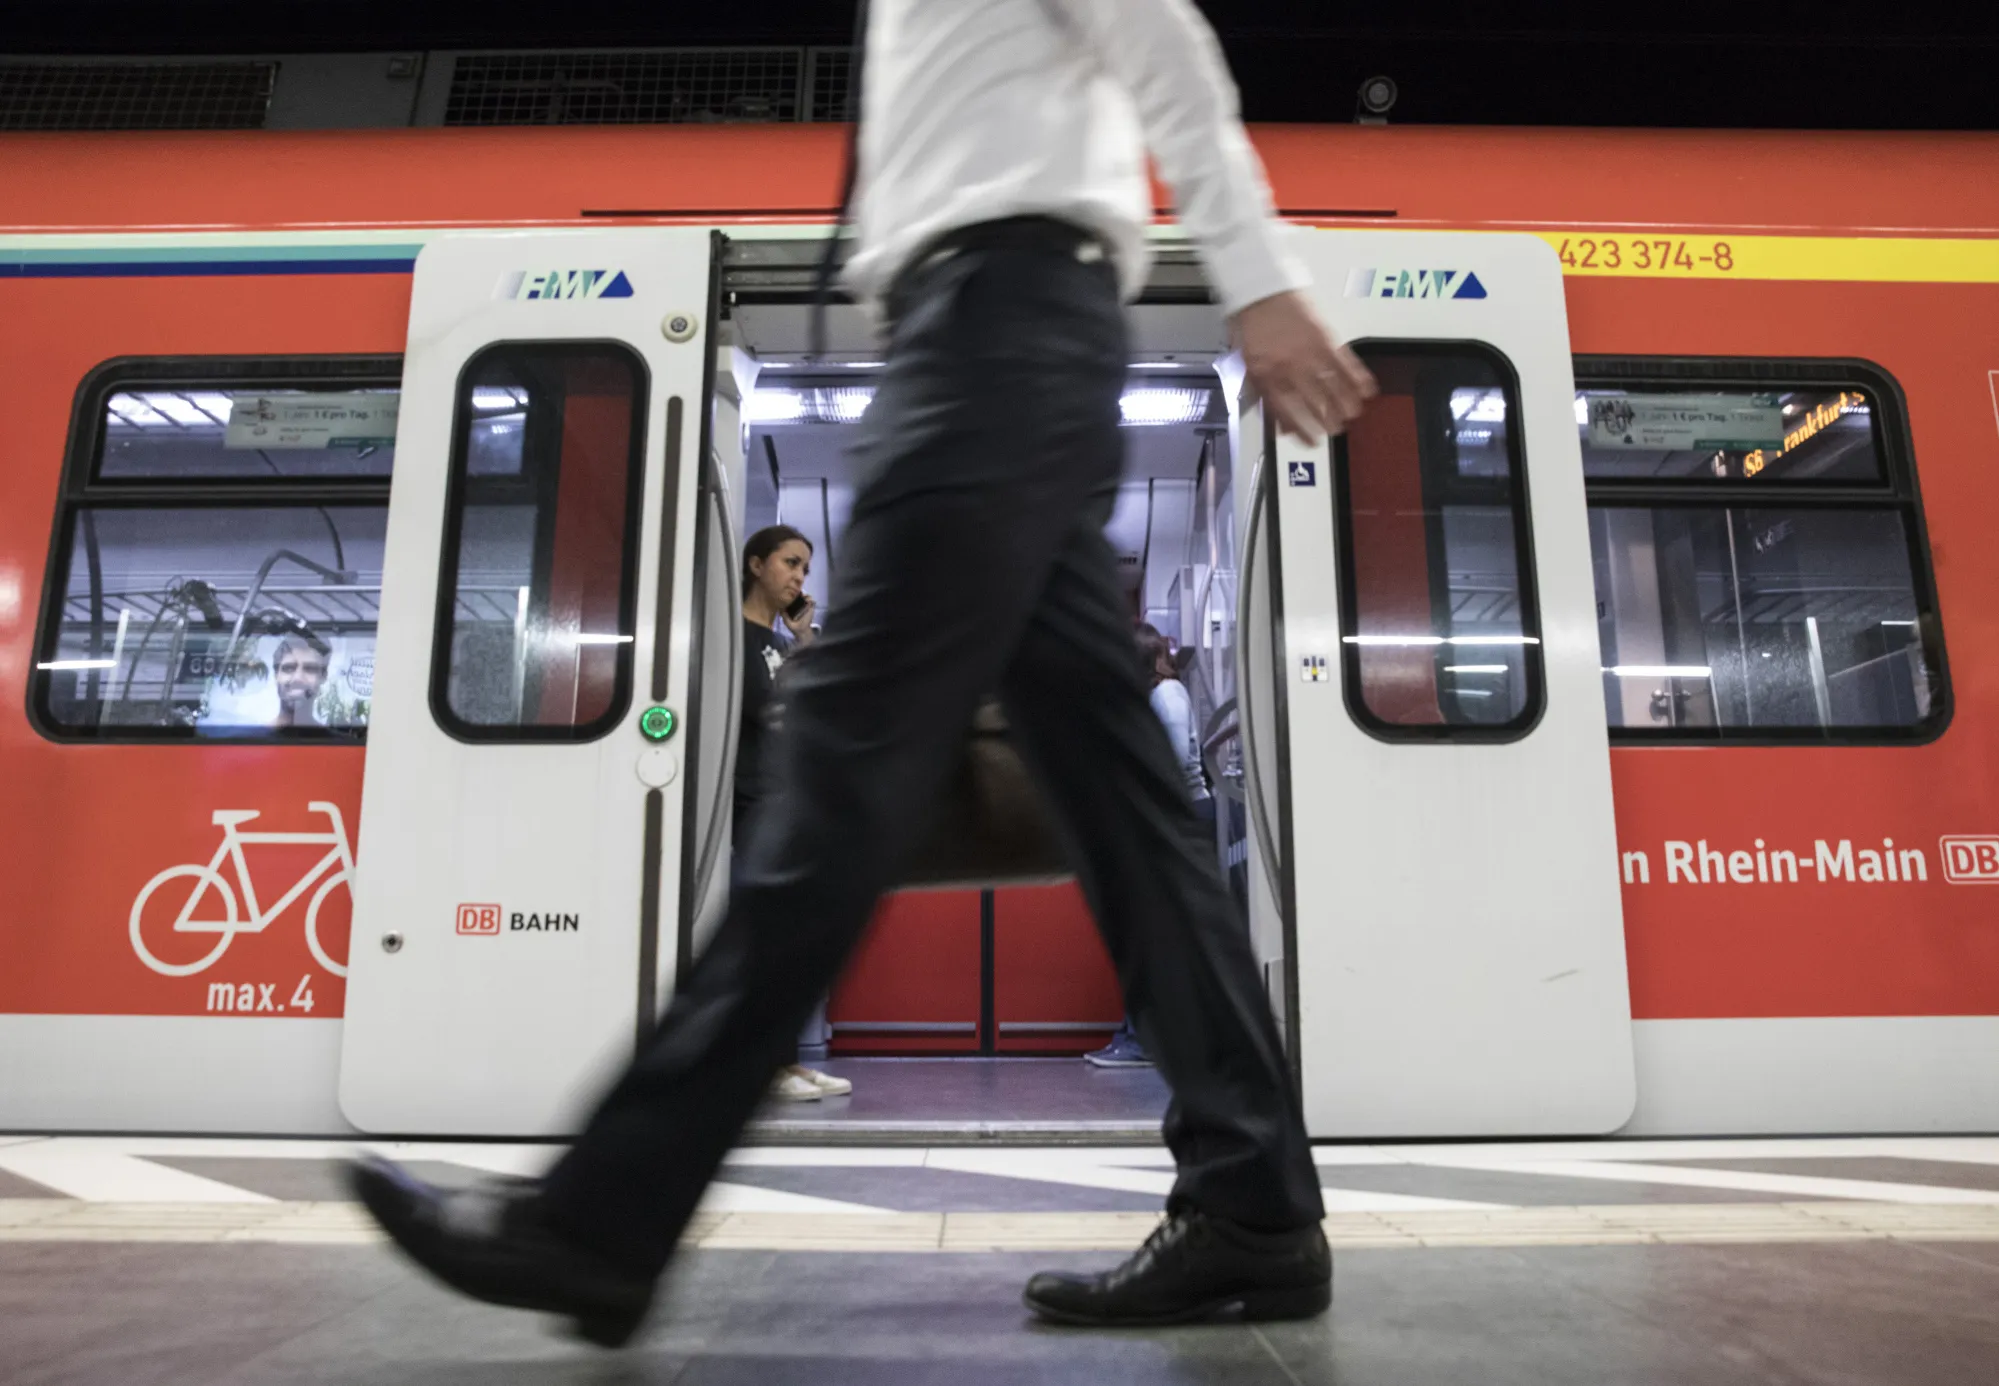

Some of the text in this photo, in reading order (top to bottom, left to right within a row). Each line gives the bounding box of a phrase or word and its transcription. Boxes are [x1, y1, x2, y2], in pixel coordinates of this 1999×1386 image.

[1559, 239, 1734, 271] 423 374-8
[1744, 392, 1848, 477] S6 rankfurt
[1664, 838, 1928, 884] Rhein-Main
[1944, 839, 1999, 880] DB
[460, 907, 579, 933] DB BAHN
